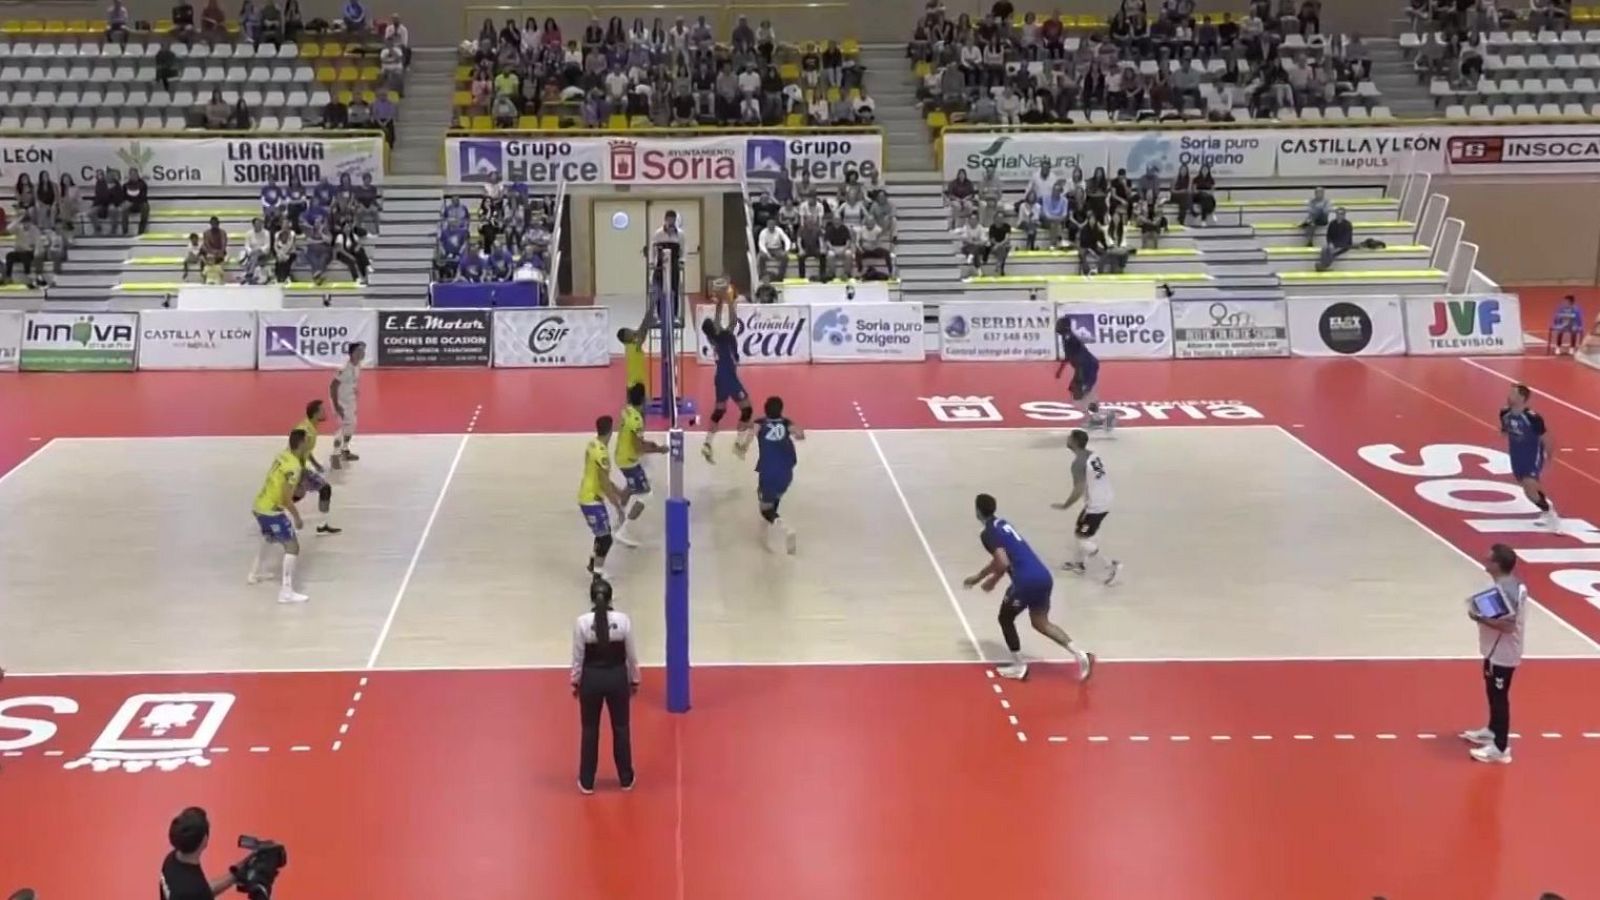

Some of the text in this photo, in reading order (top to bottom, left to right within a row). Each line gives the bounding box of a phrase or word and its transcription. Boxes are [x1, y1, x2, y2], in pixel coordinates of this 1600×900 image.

[228, 141, 324, 161] LA CURVA
[506, 141, 571, 160] Grupo
[790, 140, 851, 158] Grupo
[1181, 136, 1259, 152] Soria puro
[1280, 133, 1441, 155] CASTILLA Y LEÓN
[1508, 142, 1600, 157] INSOCA
[3, 144, 53, 163] LEÓN
[152, 165, 201, 182] Soria
[234, 163, 321, 183] SORIANA
[508, 160, 598, 182] Herce
[642, 150, 735, 180] Soria
[790, 158, 877, 179] Herce
[856, 318, 922, 334] Soria puro
[971, 317, 1050, 328] SERBIAM
[1098, 314, 1145, 328] Grupo
[1429, 300, 1501, 336] JVF
[144, 330, 201, 340] CASTILLA
[207, 330, 216, 341] Y
[300, 326, 348, 339] Grupo
[383, 336, 423, 345] COCHES
[425, 336, 438, 344] DE
[537, 328, 570, 342] CSIF
[1099, 328, 1165, 344] Herce
[1430, 337, 1504, 348] TELEVISIÓN
[1020, 402, 1264, 421] Soria
[765, 424, 785, 441] 20
[1003, 524, 1022, 541] 7
